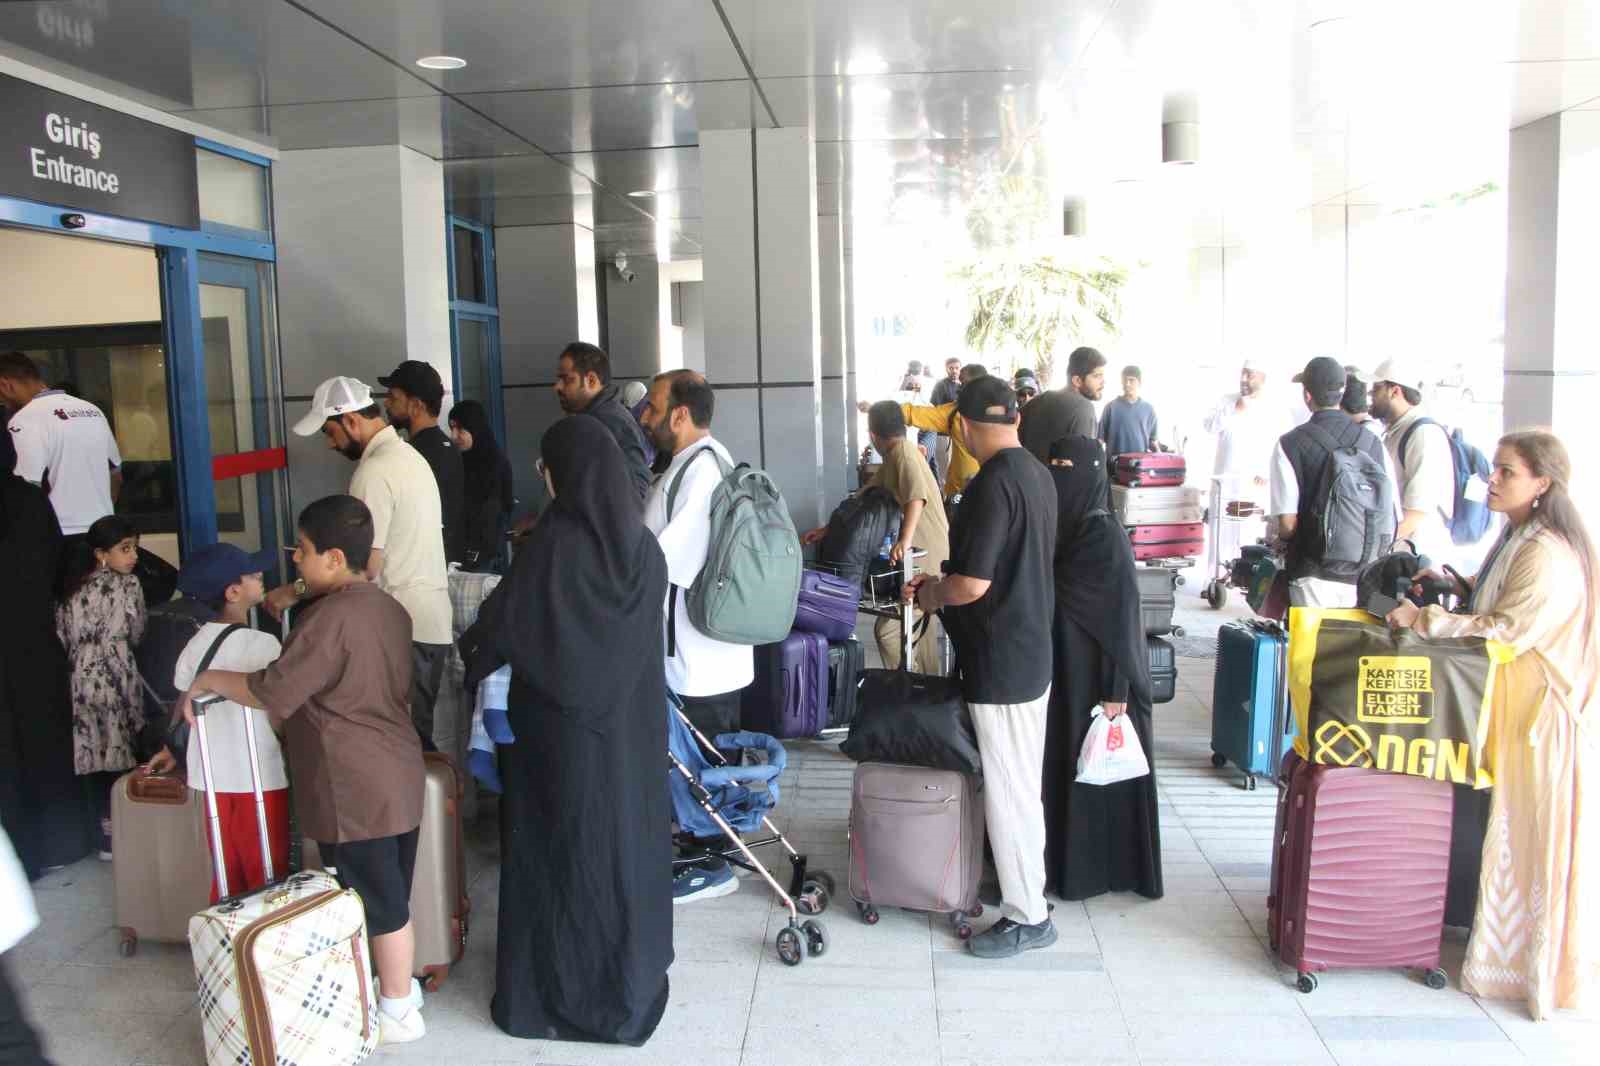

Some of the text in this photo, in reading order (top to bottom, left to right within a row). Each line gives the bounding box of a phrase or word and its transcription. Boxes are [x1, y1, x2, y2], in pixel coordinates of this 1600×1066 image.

[46, 112, 101, 159] Giriş
[31, 147, 119, 194] Entrance
[1366, 693, 1418, 705] ELDEN
